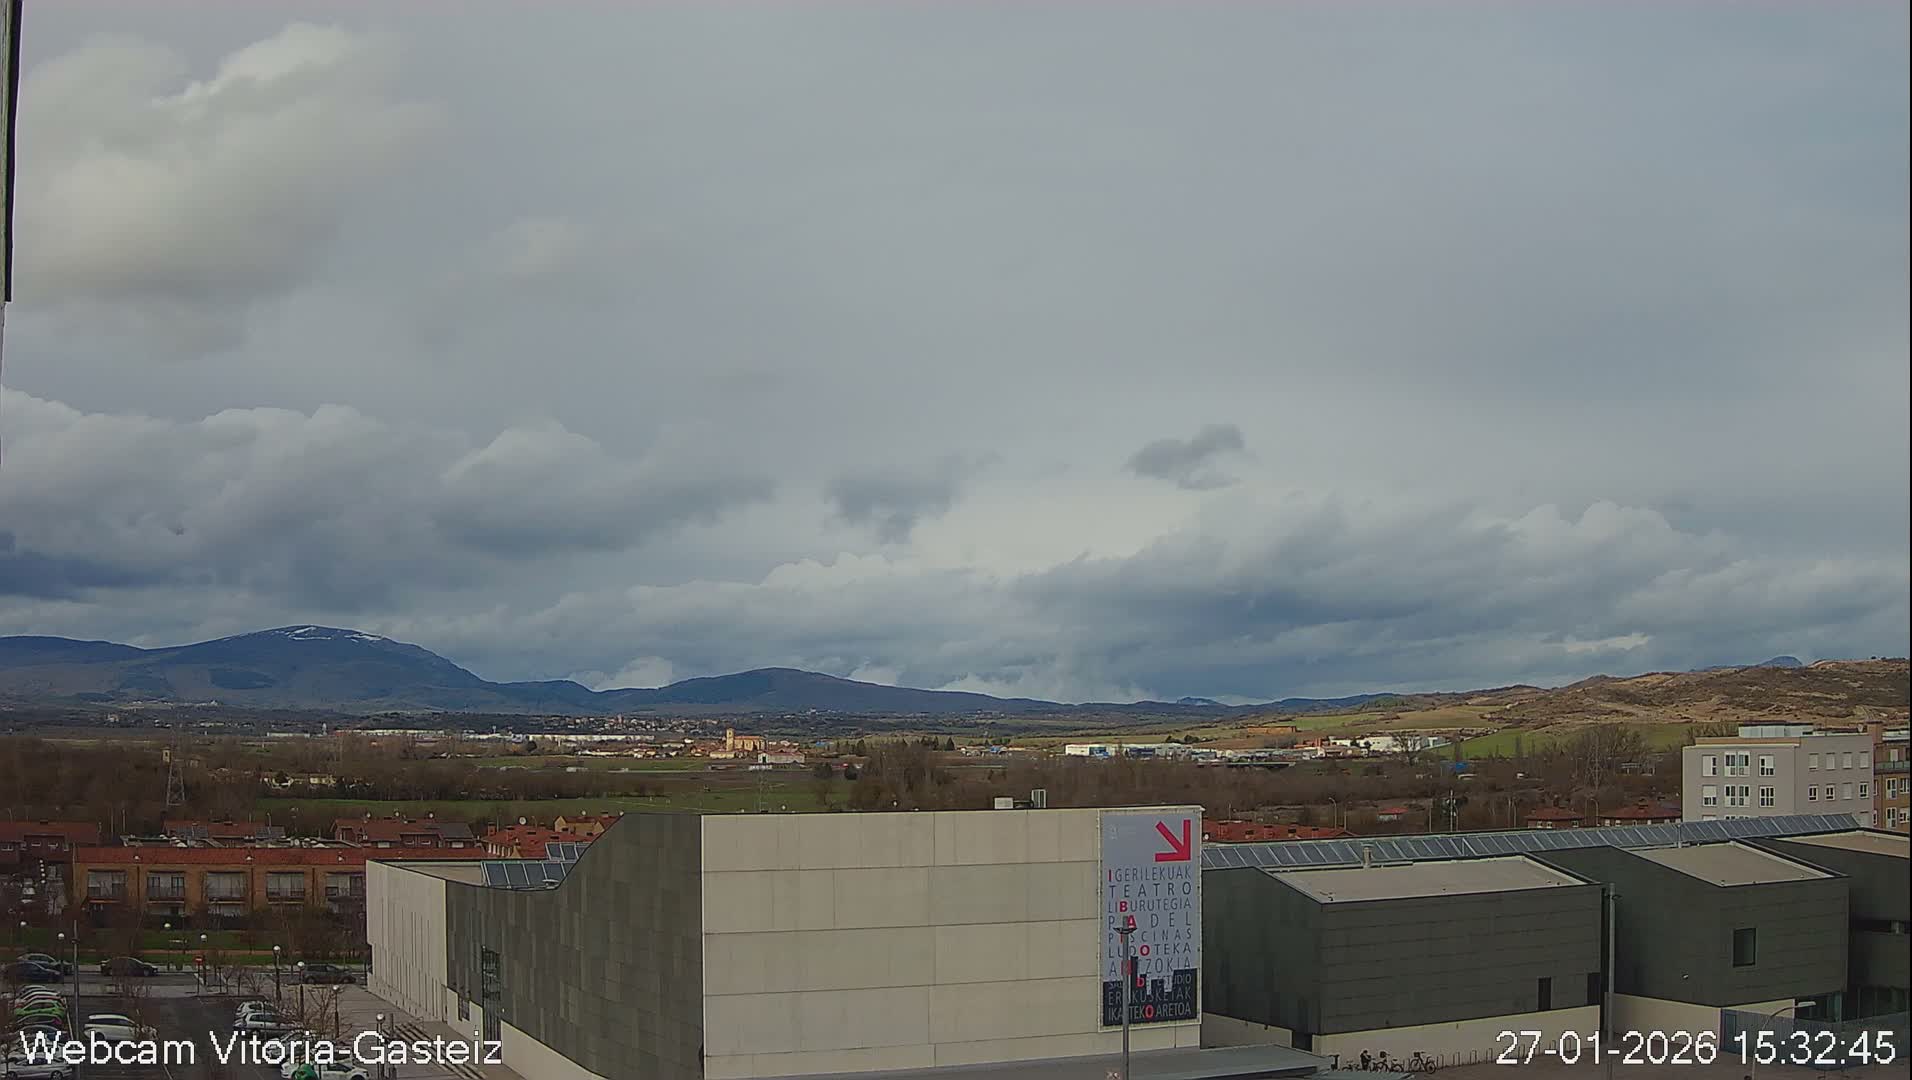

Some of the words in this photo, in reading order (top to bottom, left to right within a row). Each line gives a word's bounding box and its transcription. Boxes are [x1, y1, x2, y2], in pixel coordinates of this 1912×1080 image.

[1108, 866, 1192, 882] IGERILEKUAK
[1109, 881, 1192, 898] TEATRO
[1108, 898, 1192, 913] LIBURUTEGIA
[1108, 987, 1192, 1006] ERKUSKETAK
[1108, 1004, 1154, 1021] IKATEKO
[1156, 1002, 1192, 1017] ARETOA
